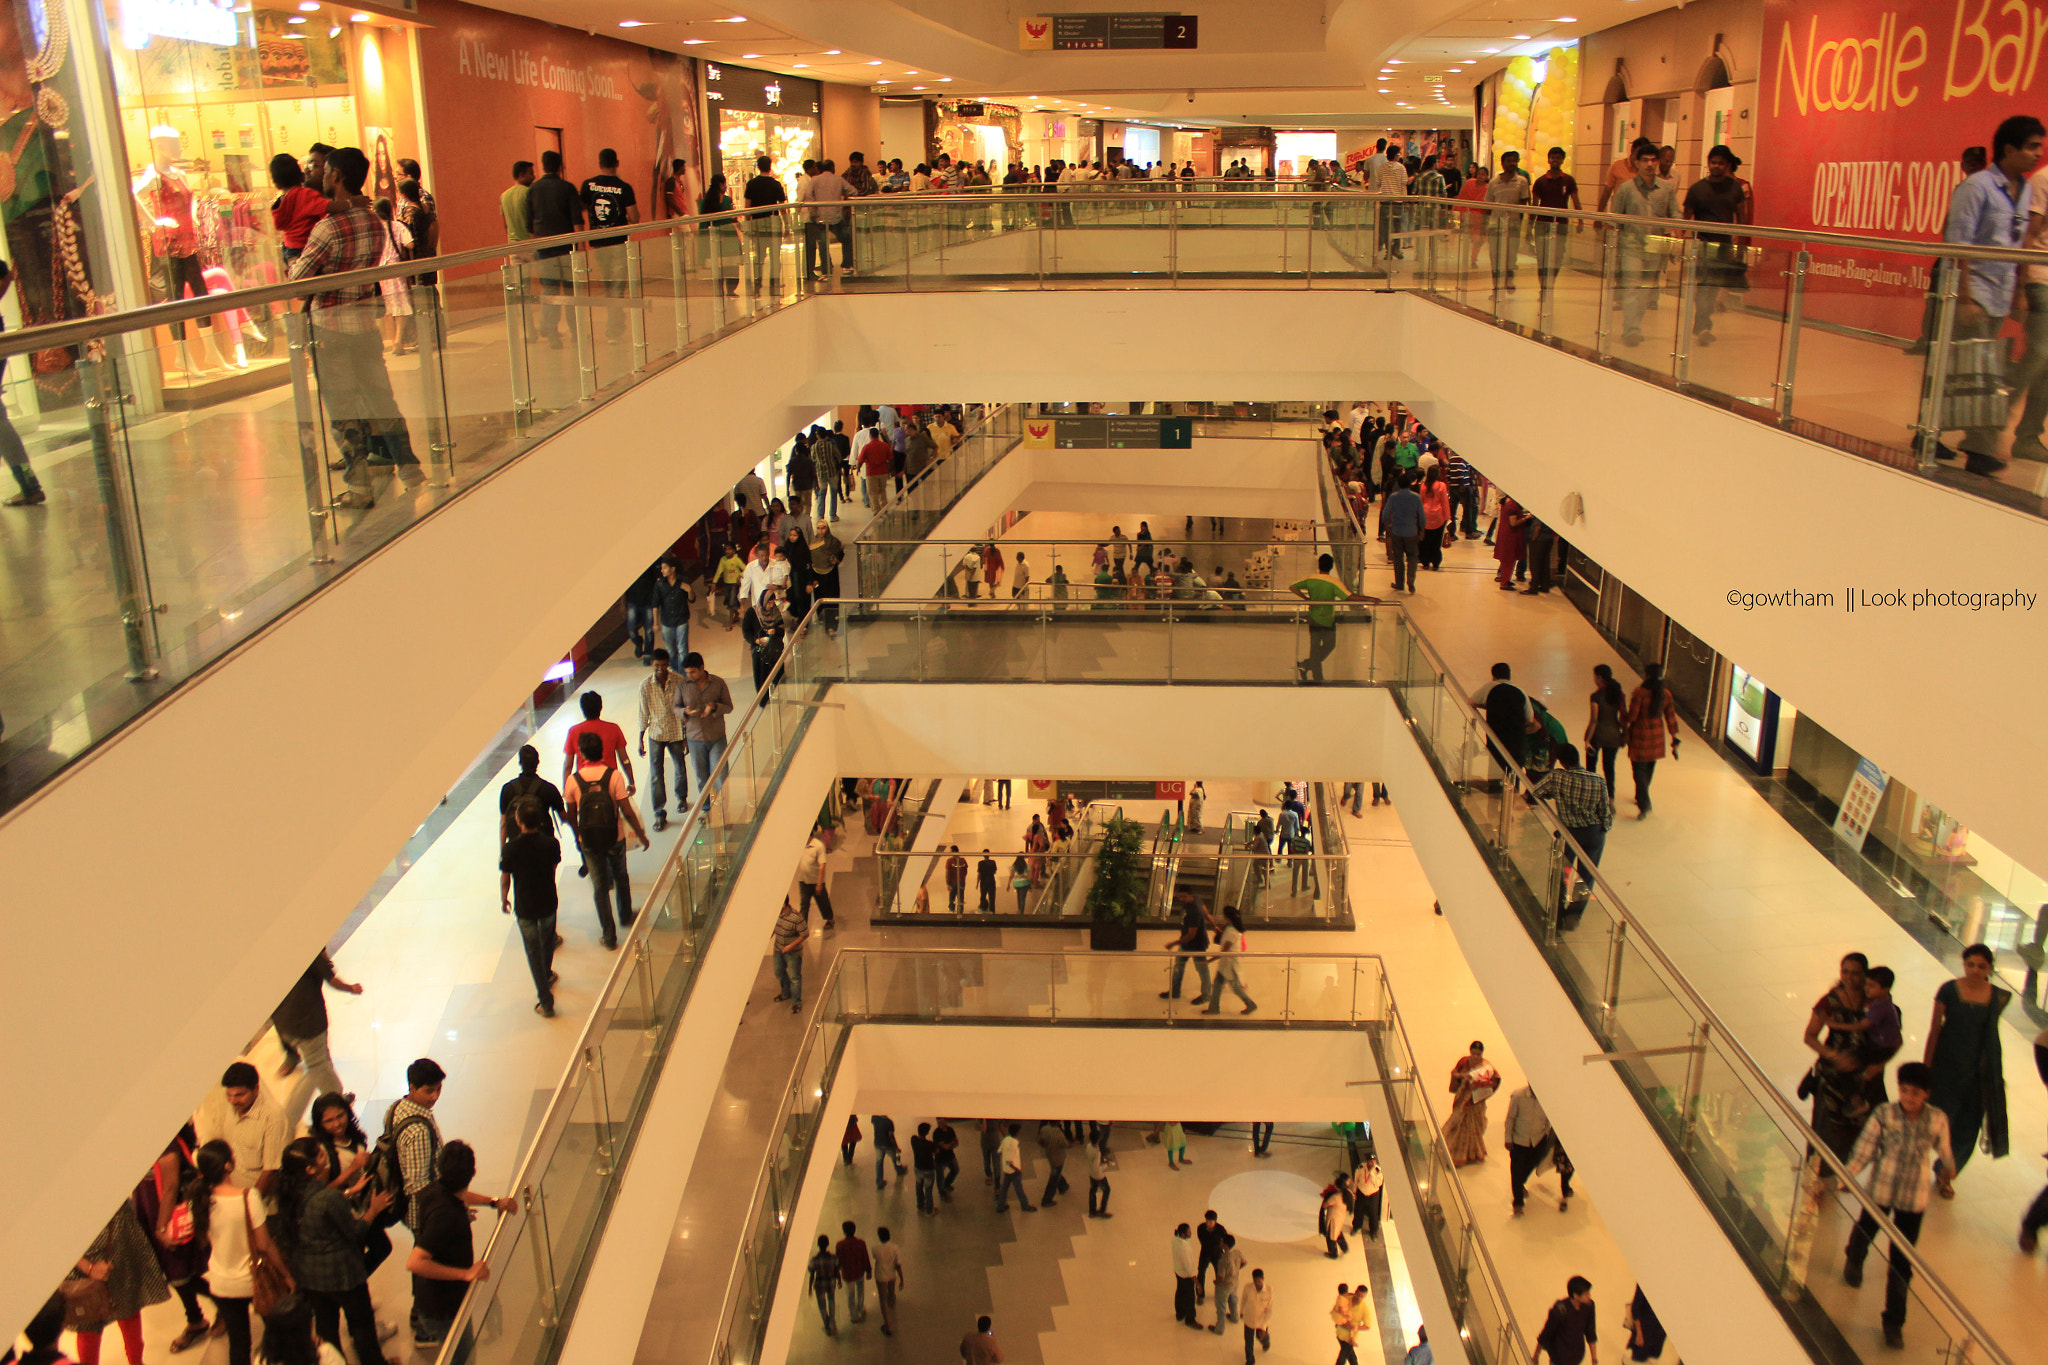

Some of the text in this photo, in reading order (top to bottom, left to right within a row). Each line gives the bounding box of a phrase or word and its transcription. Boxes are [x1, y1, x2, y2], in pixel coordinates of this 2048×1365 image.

[1176, 25, 1187, 39] 2
[459, 37, 472, 76] A
[473, 40, 509, 82] New
[512, 49, 539, 87] Life
[540, 55, 587, 102] Coming
[1774, 0, 2048, 118] Noodle Bar
[1811, 161, 1903, 232] OPENING
[1807, 254, 1842, 278] hennai
[1174, 428, 1181, 440] 1
[1160, 782, 1182, 793] UG
